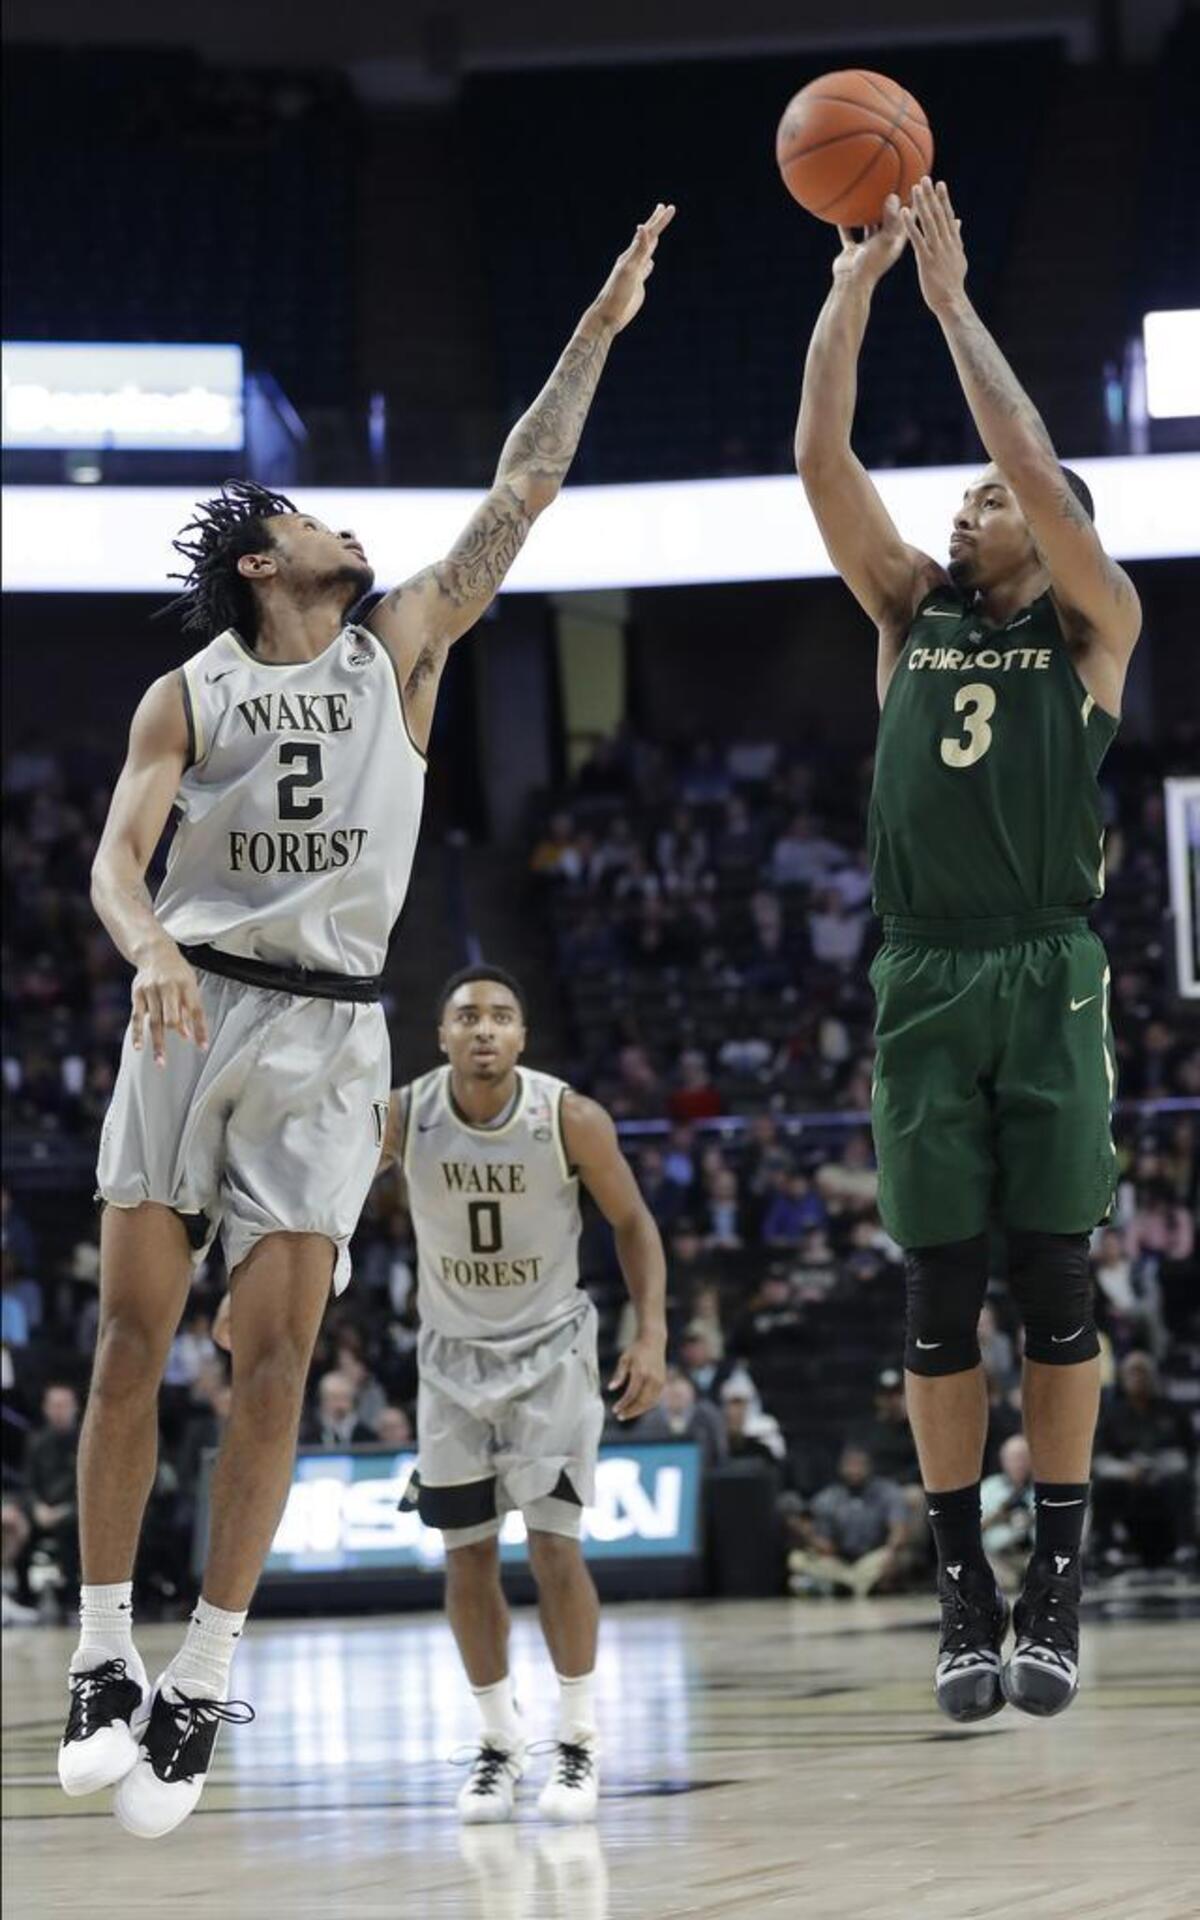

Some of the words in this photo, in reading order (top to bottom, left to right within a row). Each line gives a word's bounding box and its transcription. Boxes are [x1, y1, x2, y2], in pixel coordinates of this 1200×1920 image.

[237, 692, 352, 736] WAKE
[940, 683, 996, 768] 3
[277, 742, 323, 820] 2
[229, 828, 368, 874] FOREST
[441, 1162, 526, 1193] WAKE
[468, 1201, 502, 1253] 0
[441, 1256, 543, 1287] FOREST
